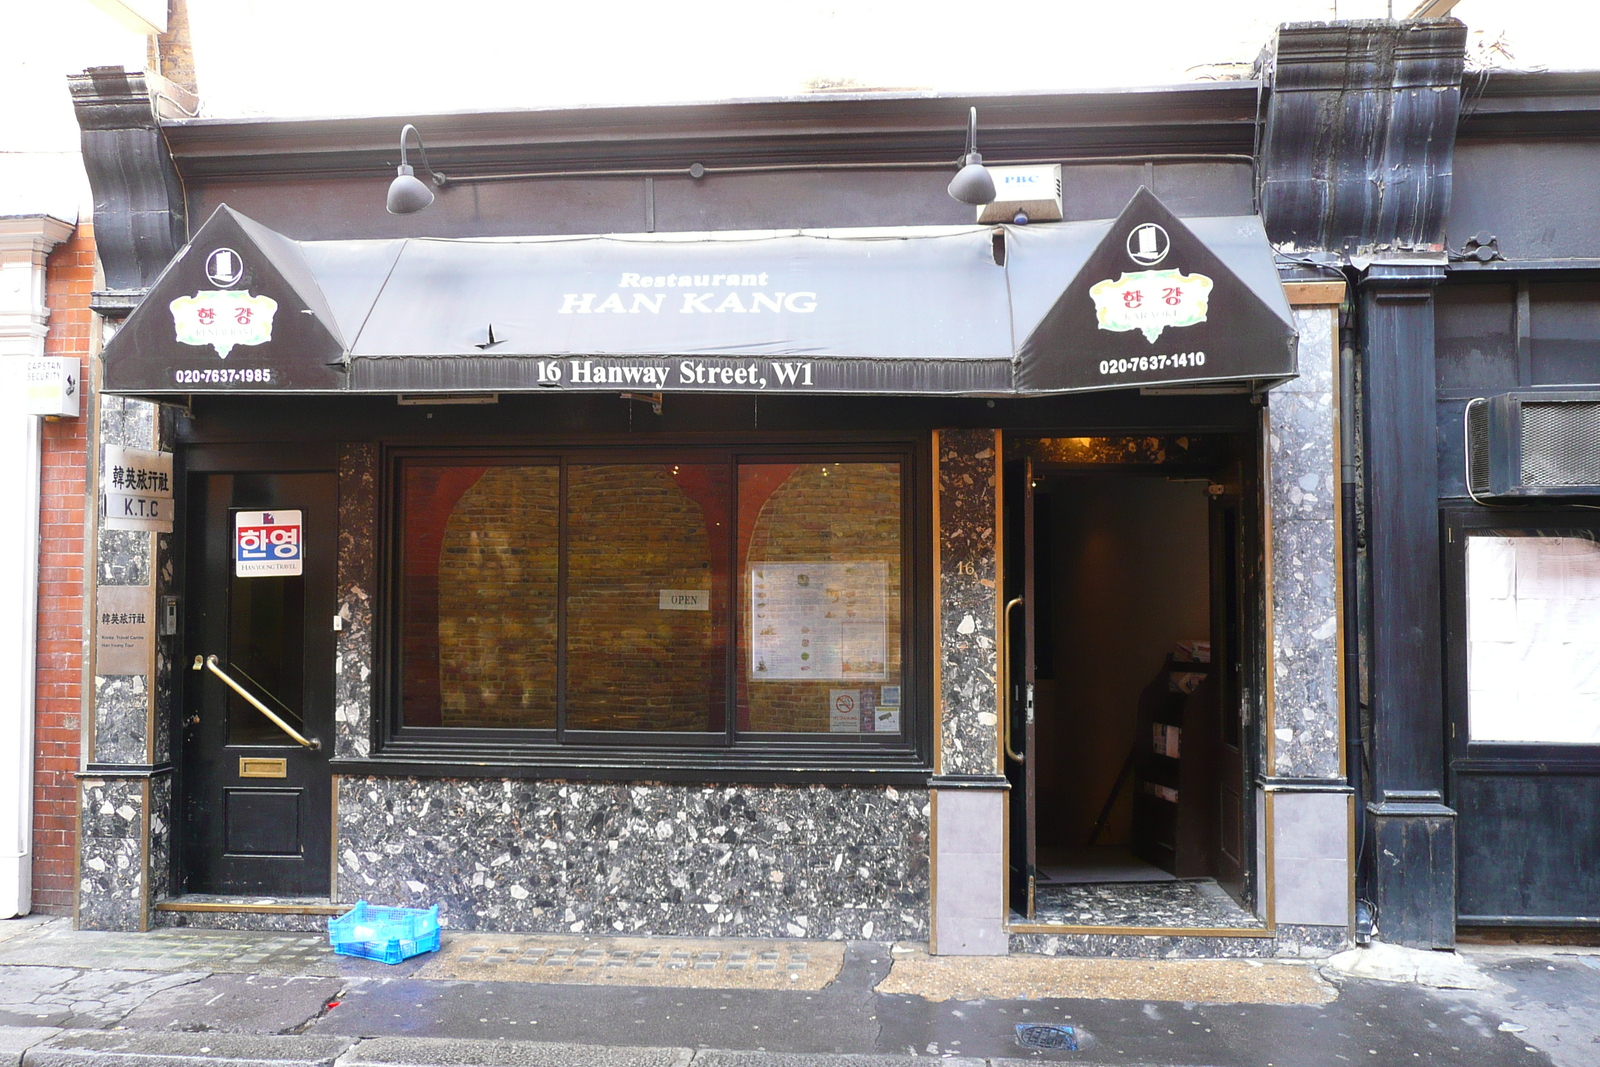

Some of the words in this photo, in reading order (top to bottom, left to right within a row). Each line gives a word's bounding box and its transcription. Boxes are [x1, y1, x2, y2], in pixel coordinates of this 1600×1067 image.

[617, 271, 769, 288] Restaurant
[557, 292, 667, 315] HAN
[679, 291, 818, 314] KANG
[28, 362, 61, 371] CAPSTAN
[536, 360, 562, 382] 16
[570, 360, 670, 389] Hanway
[679, 361, 766, 389] Street,
[771, 362, 814, 386] W1
[27, 372, 60, 381] SECURITY
[112, 464, 169, 492] 韓英旅行社
[124, 498, 159, 517] K.T.C
[240, 528, 298, 558] 한영
[956, 561, 975, 576] 16
[671, 594, 698, 605] OPEN
[101, 613, 146, 625] 韓英旅行社
